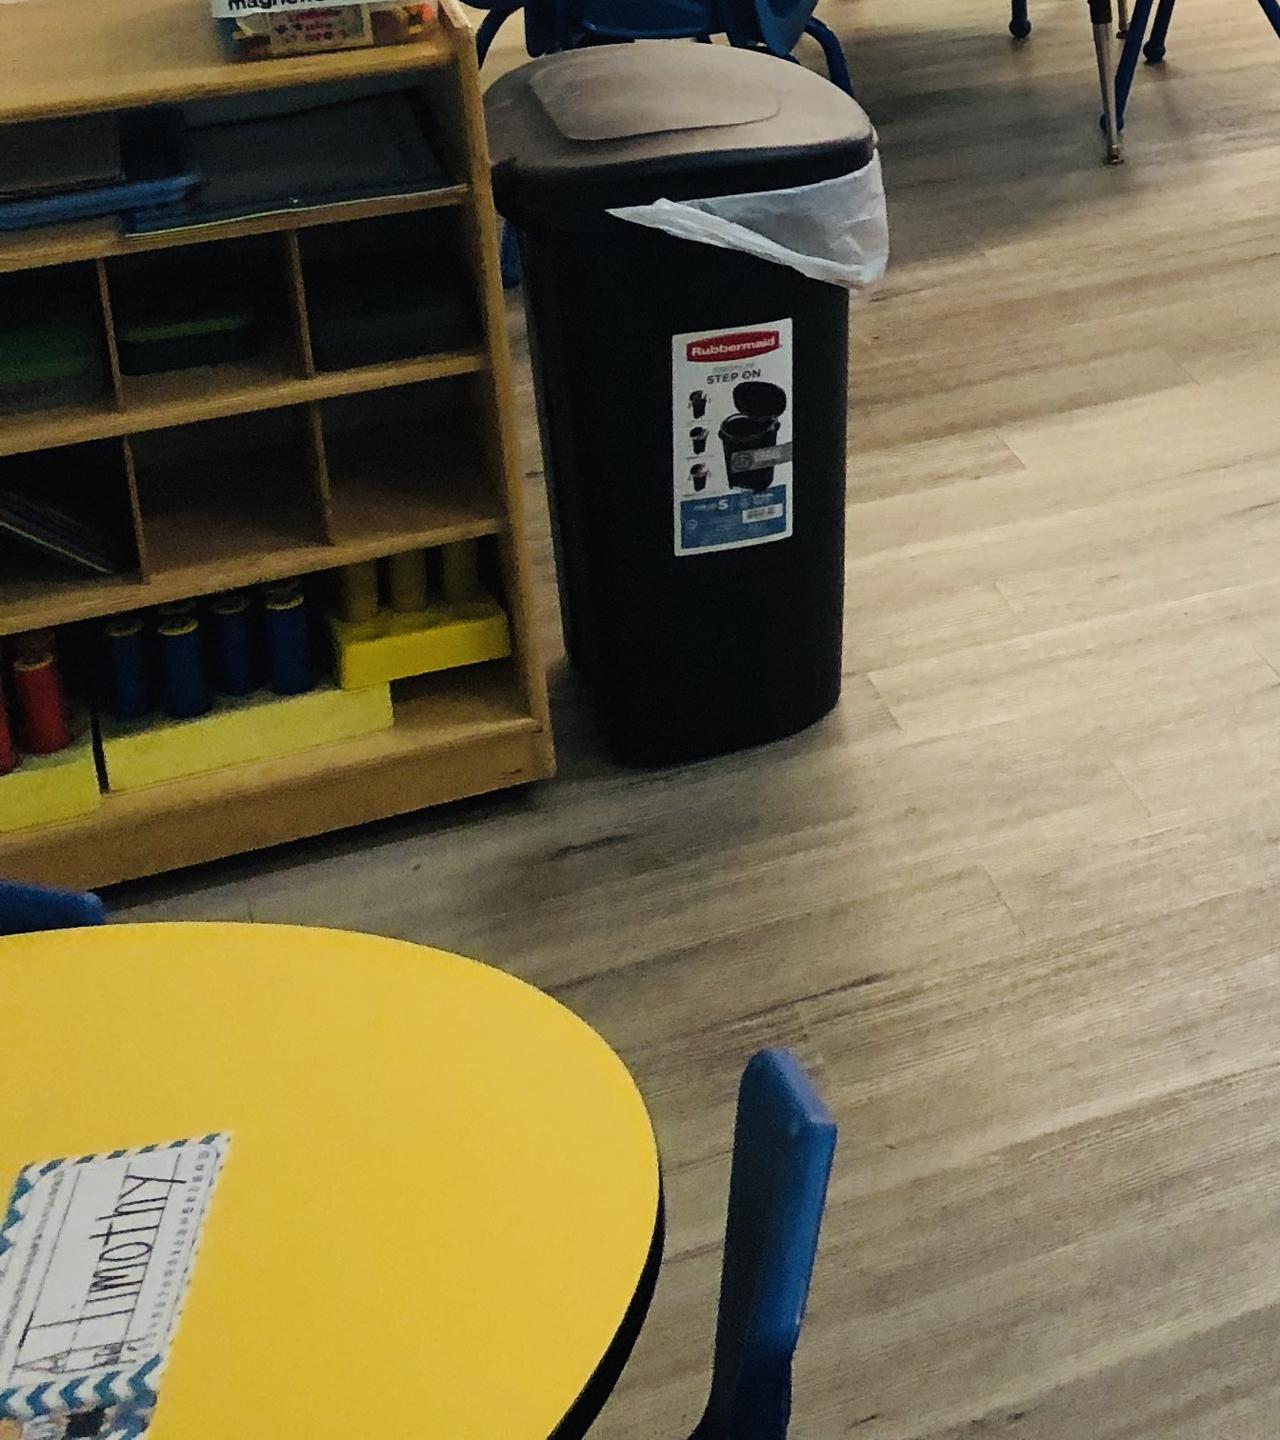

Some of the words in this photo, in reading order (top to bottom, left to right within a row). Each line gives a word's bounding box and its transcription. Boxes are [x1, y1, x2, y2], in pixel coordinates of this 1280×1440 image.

[691, 335, 776, 357] Rubbermaid
[706, 372, 739, 385] STEP
[742, 369, 761, 380] ON
[19, 1173, 189, 1349] Timothy
